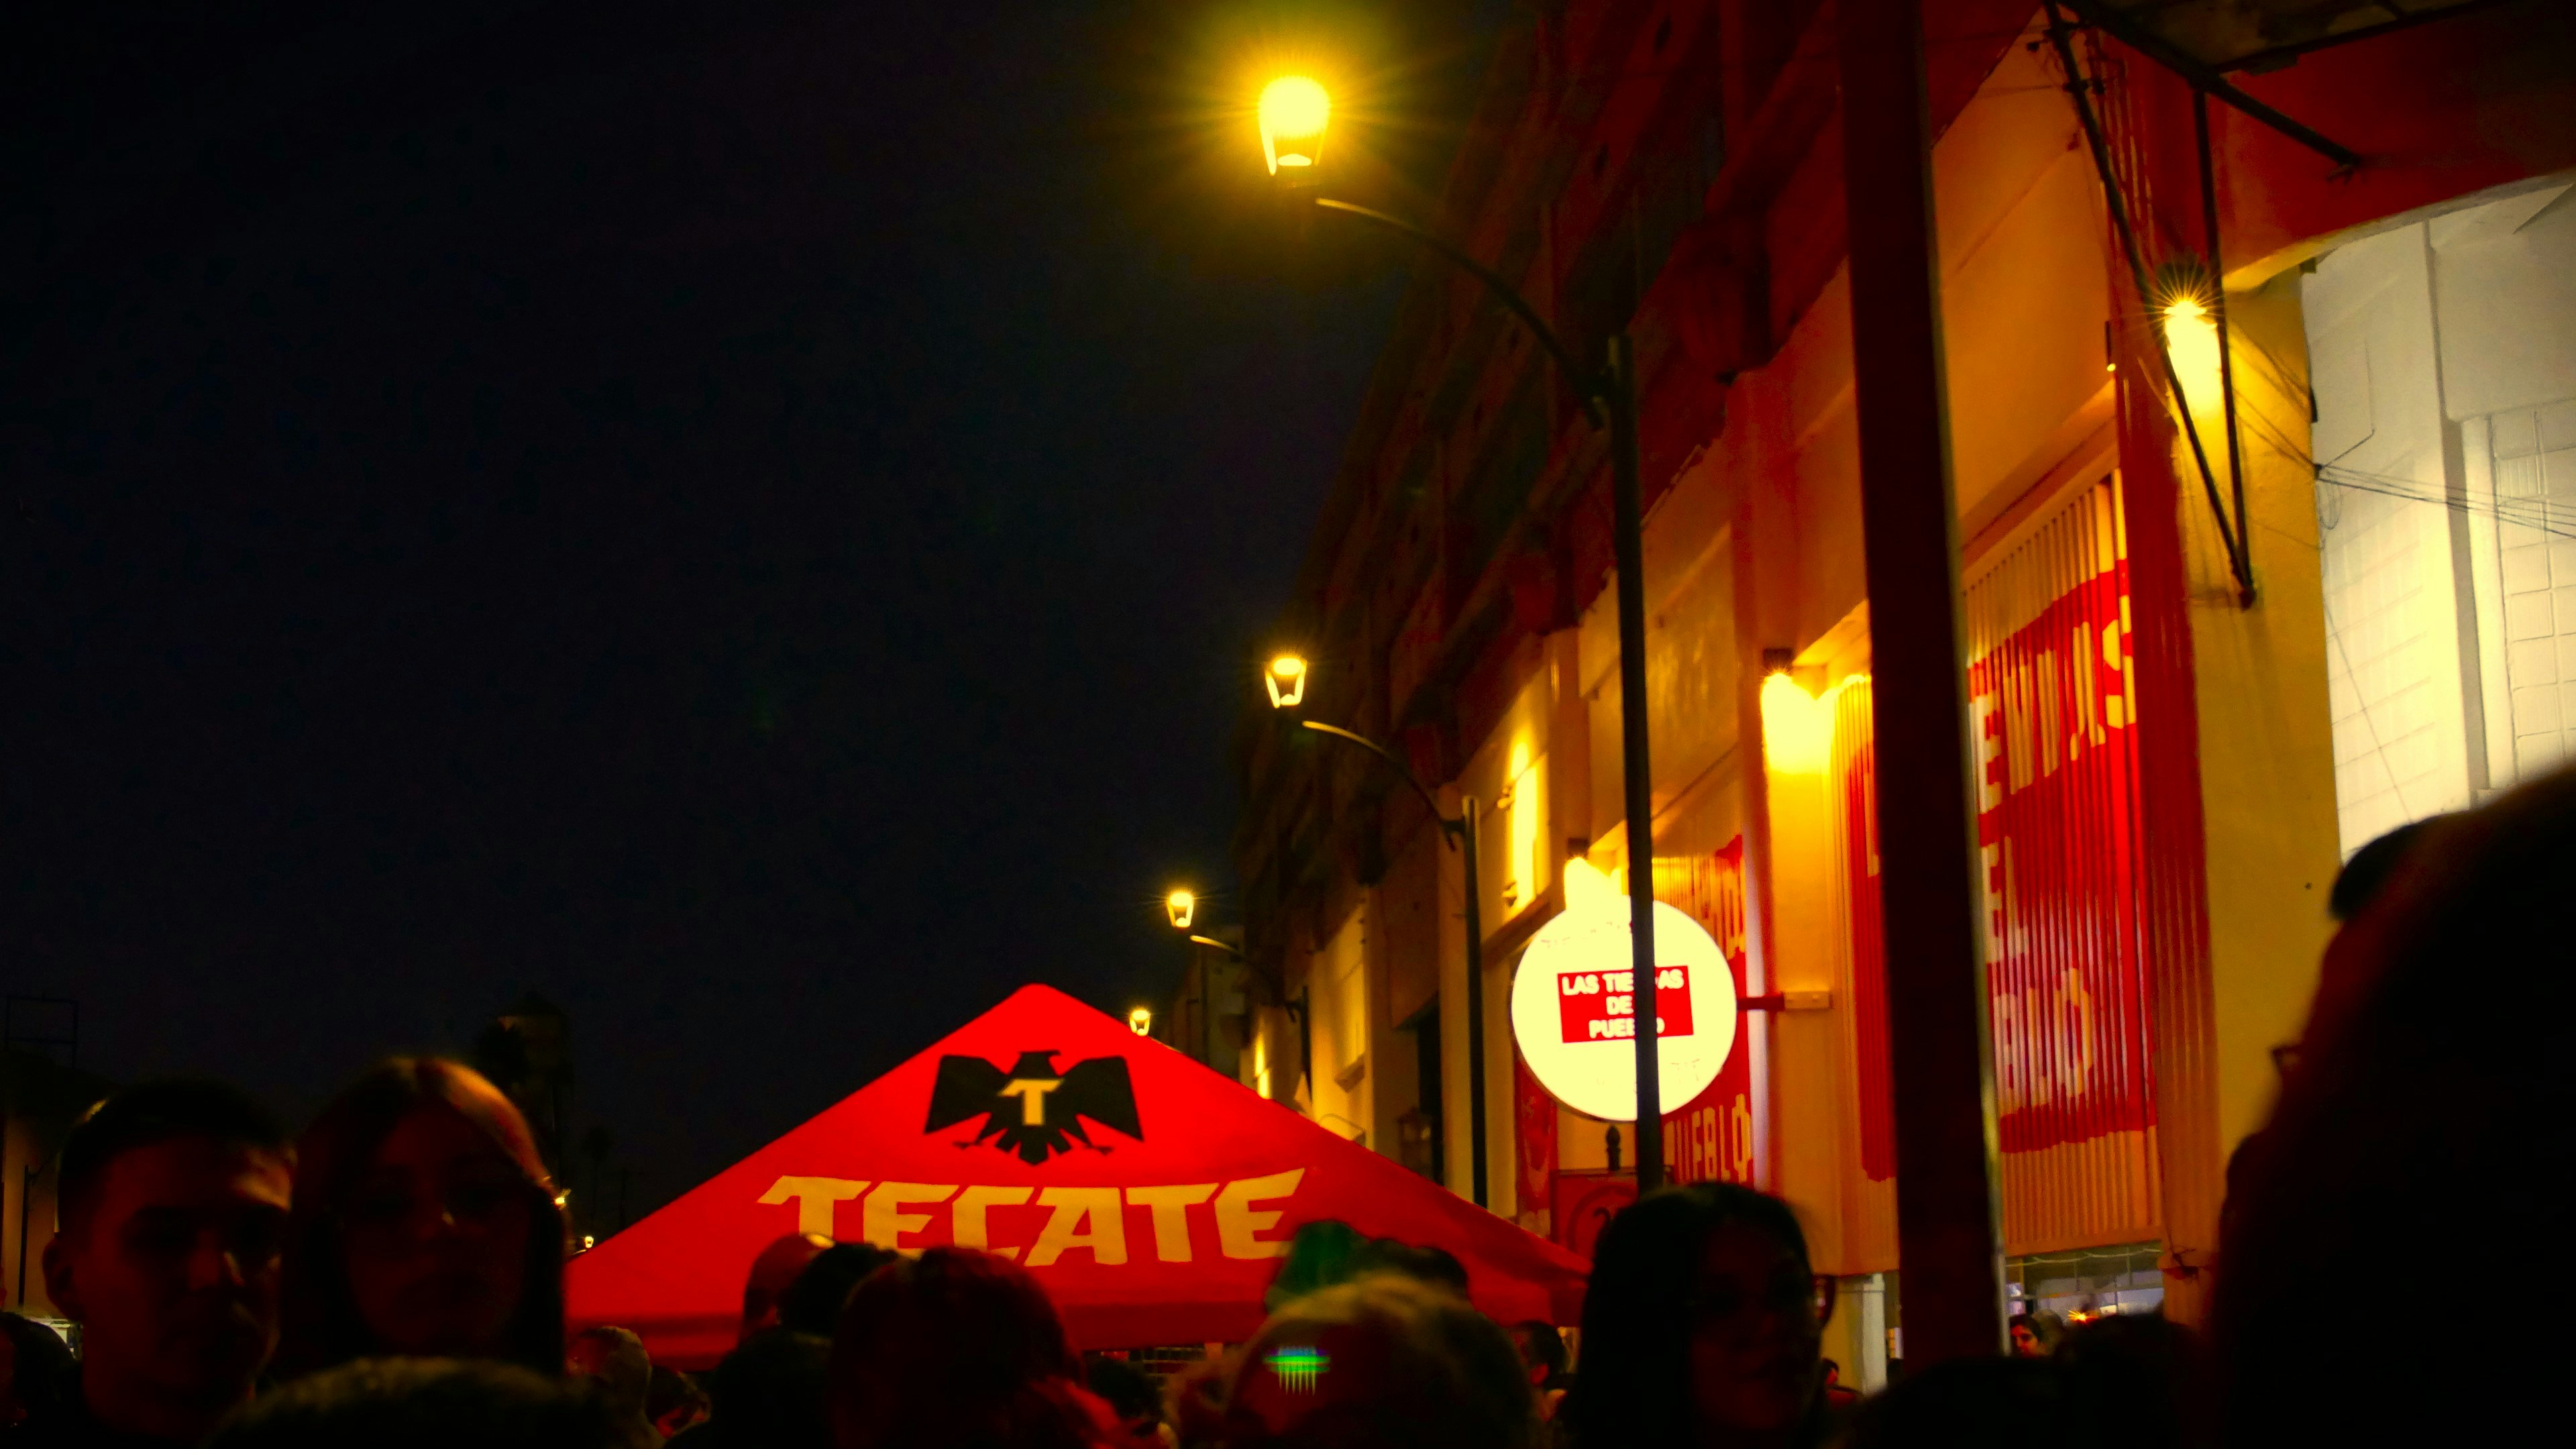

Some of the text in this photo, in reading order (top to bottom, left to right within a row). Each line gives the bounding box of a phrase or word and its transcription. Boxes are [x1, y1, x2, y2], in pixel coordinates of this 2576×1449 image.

[1968, 595, 2136, 815] ENDAS
[1980, 836, 2030, 965] EL
[1562, 968, 1684, 996] LAS TIEAS
[1606, 995, 1635, 1016] DE
[1993, 967, 2094, 1115] BLO
[997, 1078, 1065, 1127] T
[755, 1167, 1306, 1267] TECATE
